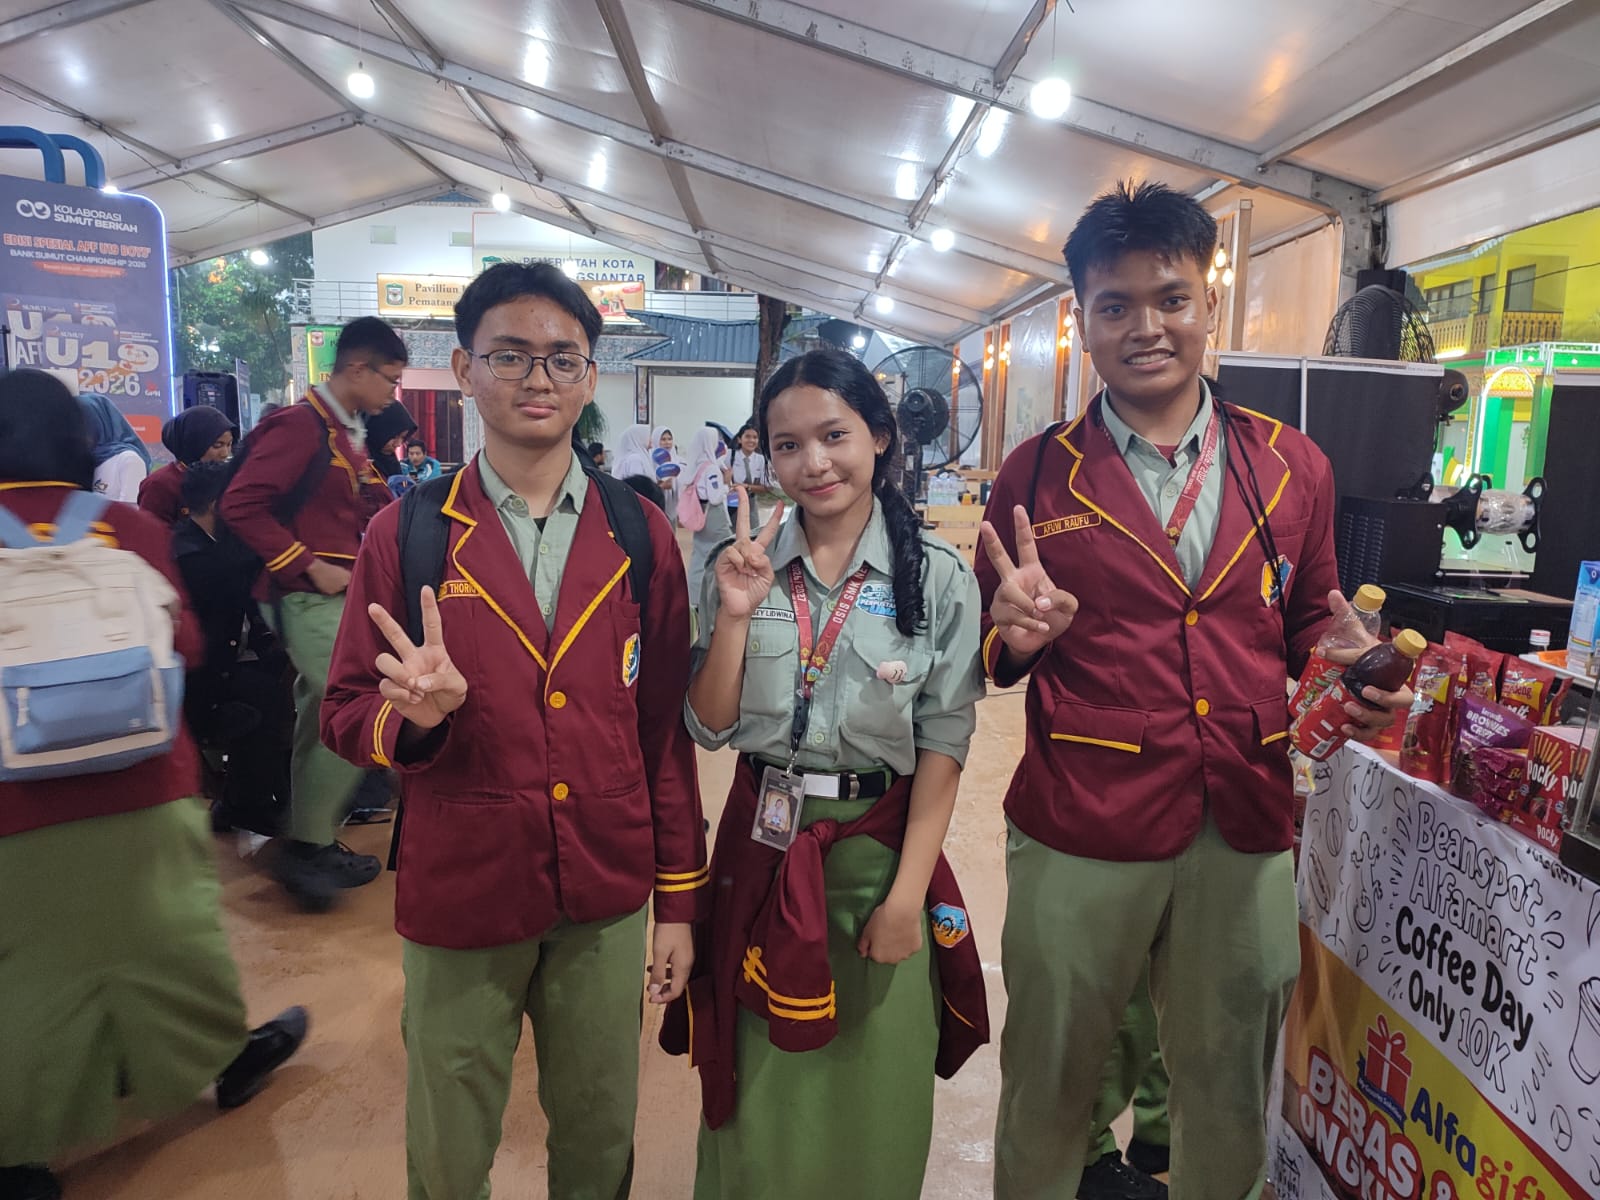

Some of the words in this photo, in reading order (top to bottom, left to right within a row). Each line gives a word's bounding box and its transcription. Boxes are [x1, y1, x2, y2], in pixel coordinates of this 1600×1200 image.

[54, 204, 122, 222] KOLABORASI
[54, 213, 93, 226] SUMUT
[94, 219, 138, 233] BERKAH
[602, 258, 635, 269] KOTA
[415, 283, 459, 294] Pavilliun
[45, 337, 160, 373] U19
[79, 368, 141, 396] 2026
[1064, 515, 1090, 529] RAUFU
[765, 610, 793, 619] LIDWINA
[832, 602, 850, 624] OSIS
[843, 580, 861, 601] SMK
[1527, 760, 1559, 792] POCKY
[1416, 801, 1543, 928] Beanspot
[1409, 857, 1538, 986] Alfamart
[1396, 906, 1476, 996] Coffee
[1481, 960, 1534, 1052] Day
[1408, 969, 1456, 1043] Only
[1457, 1007, 1511, 1094] 10K
[1309, 1054, 1417, 1198] BEBAS
[1300, 1093, 1395, 1200] ONGK
